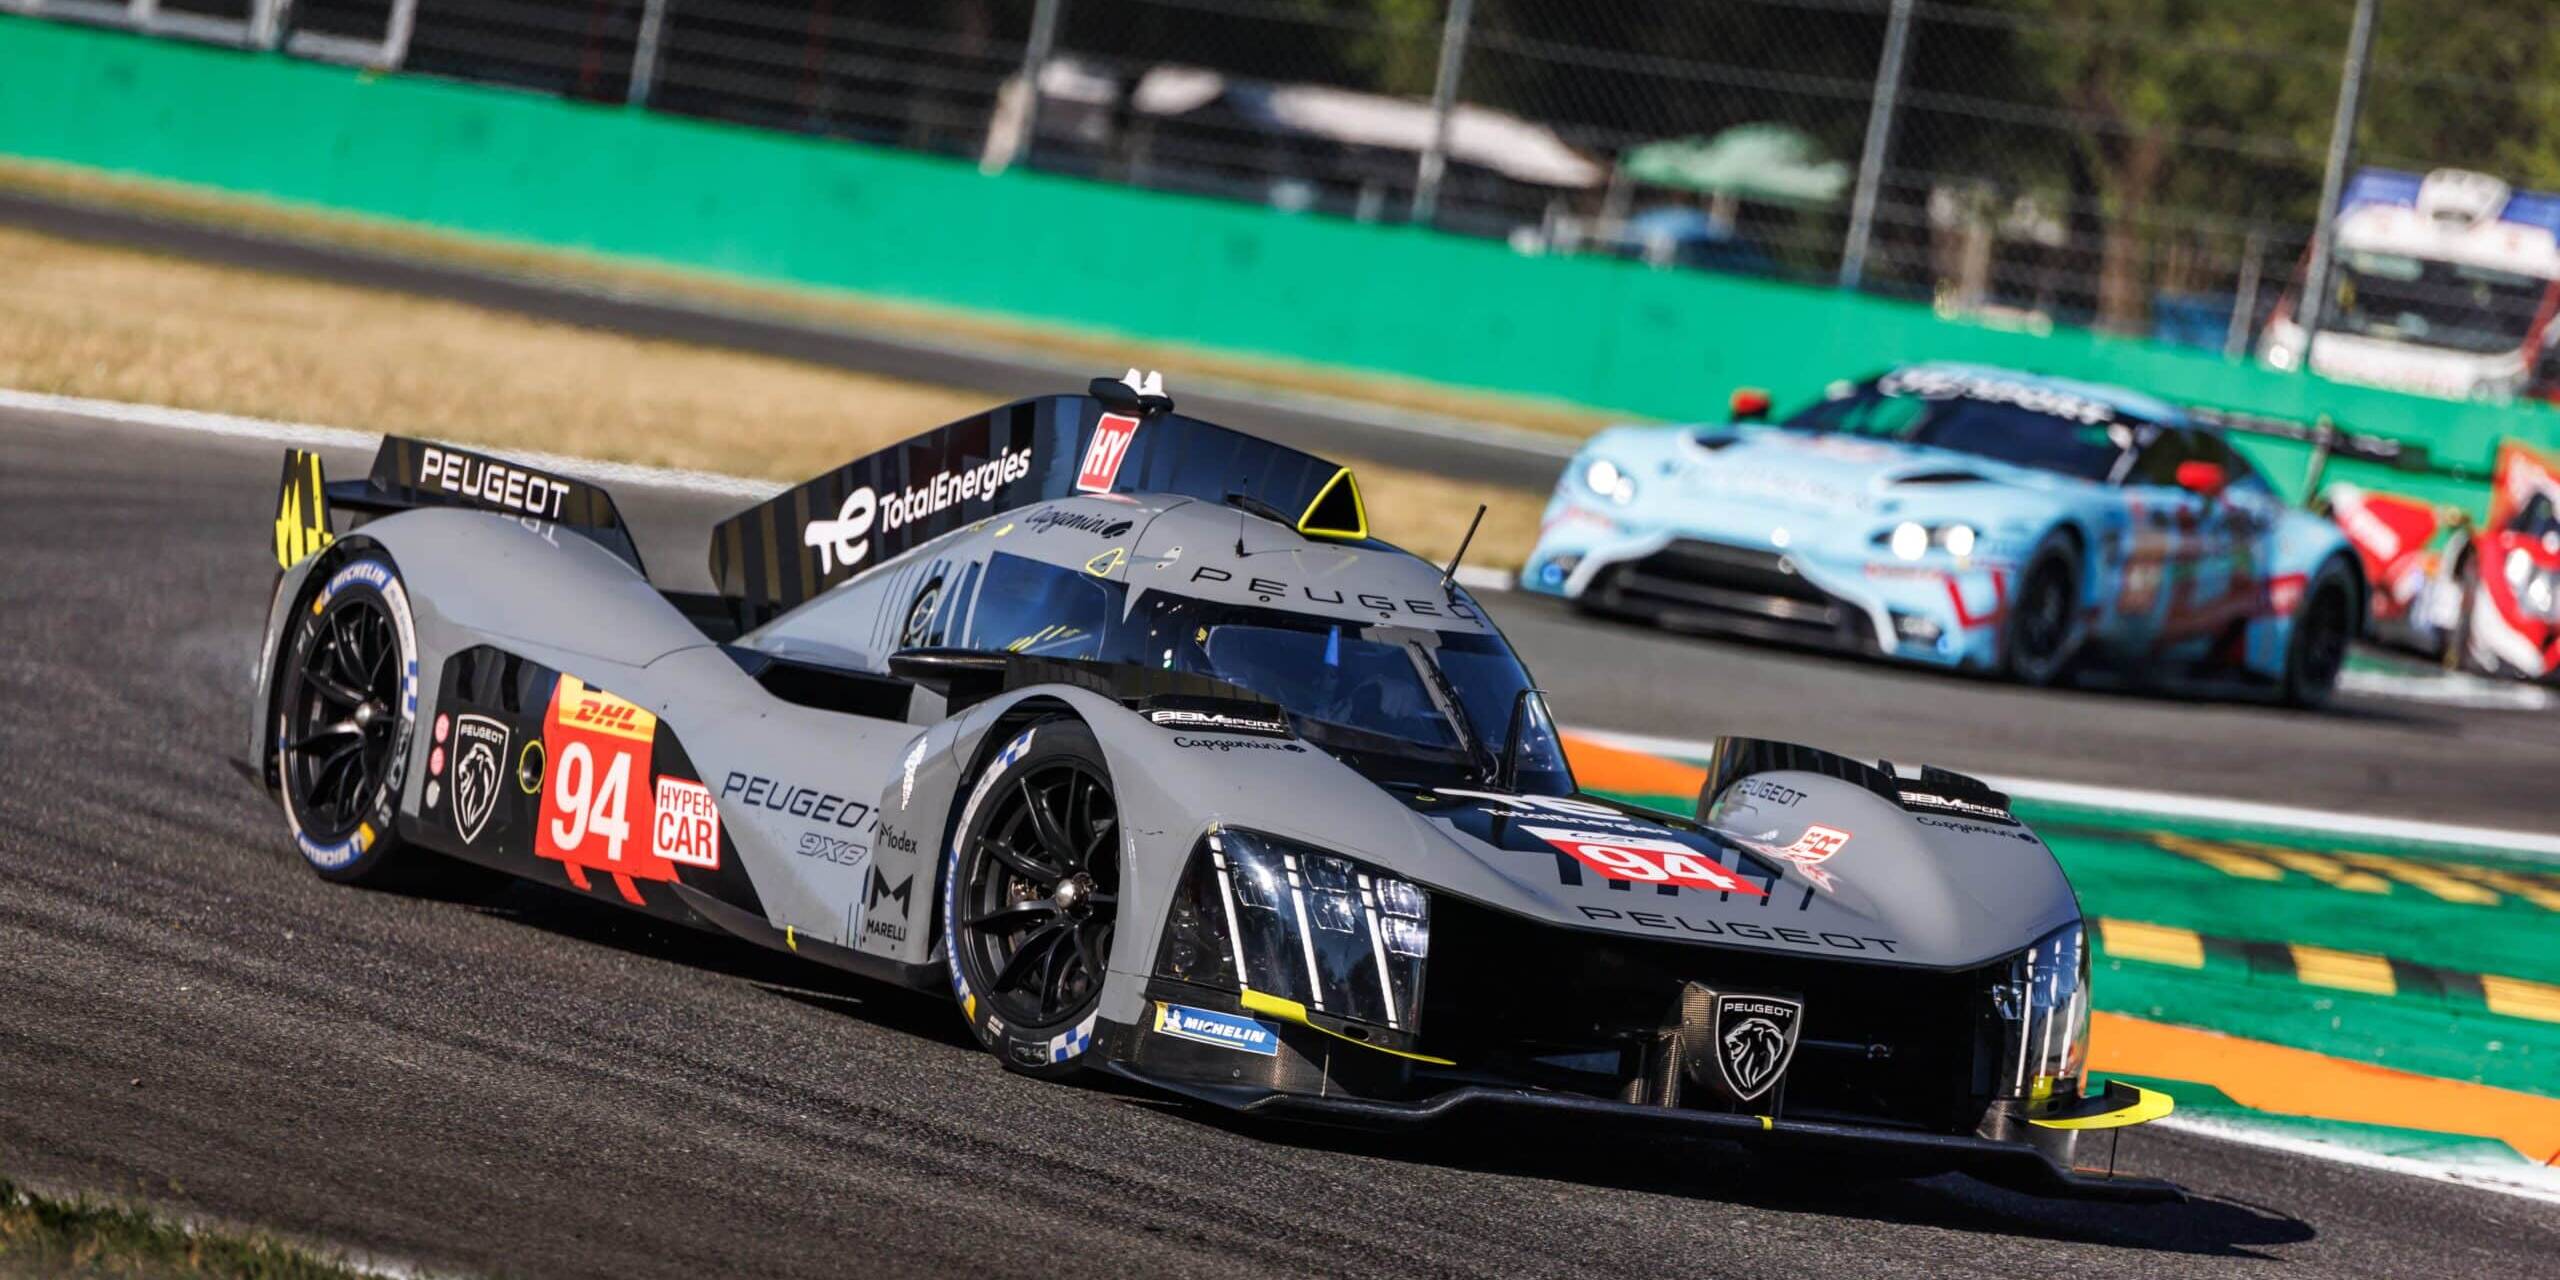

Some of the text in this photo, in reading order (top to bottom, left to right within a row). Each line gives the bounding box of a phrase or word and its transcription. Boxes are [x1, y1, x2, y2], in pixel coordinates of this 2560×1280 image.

[1084, 428, 1130, 477] HY
[420, 448, 569, 518] PEUGEOT
[879, 445, 1031, 534] TotalEnergies
[1191, 566, 1479, 620] PEUGEO
[461, 724, 504, 744] PEUGEOT
[576, 698, 638, 731] DHL
[1174, 737, 1282, 751] Capgemini
[551, 742, 632, 861] 94
[660, 784, 714, 818] HYPER
[658, 812, 713, 859] CAR
[797, 832, 868, 866] 9X8
[1576, 845, 1737, 890] 94
[866, 918, 906, 942] MARELLI
[1577, 904, 1900, 954] PEUGEOT
[1184, 1016, 1265, 1043] MICHELIN
[1723, 1002, 1795, 1018] PEUGEOT
